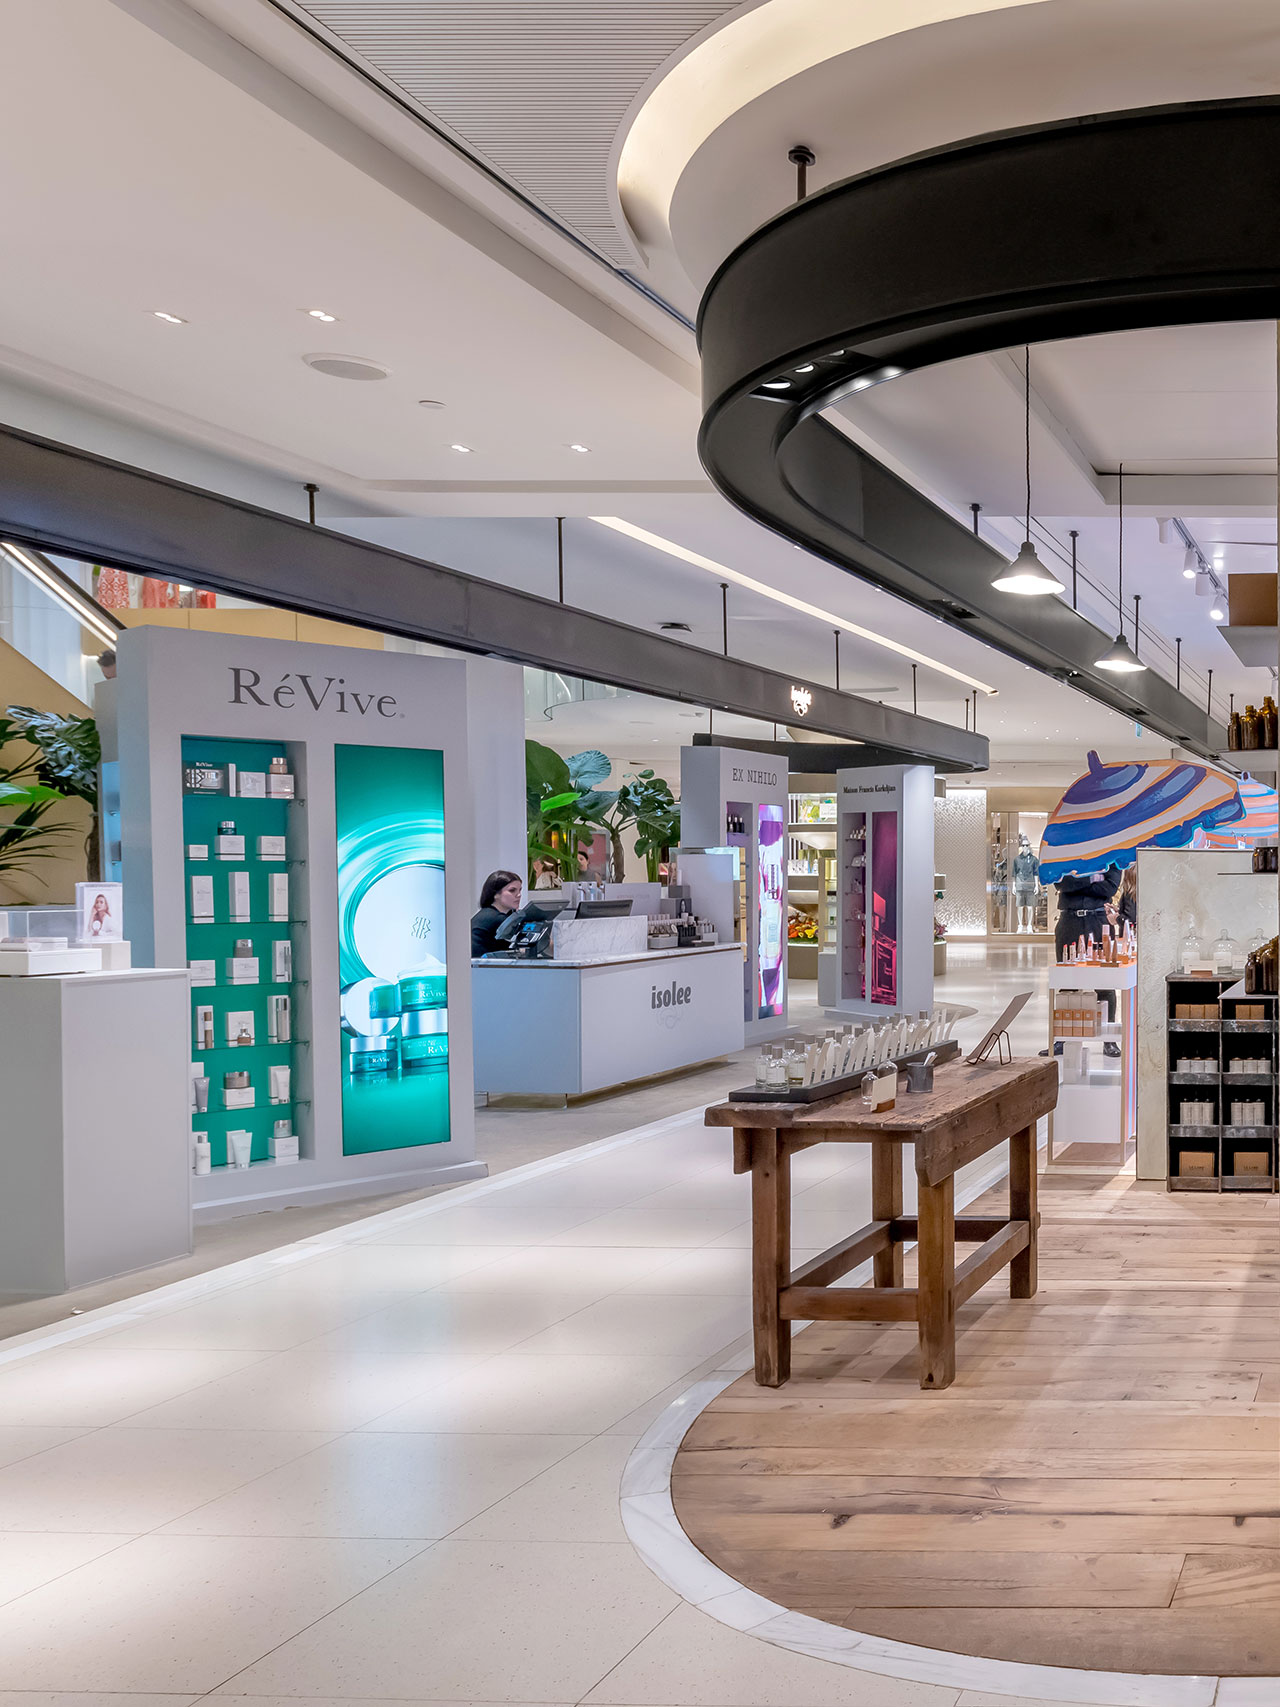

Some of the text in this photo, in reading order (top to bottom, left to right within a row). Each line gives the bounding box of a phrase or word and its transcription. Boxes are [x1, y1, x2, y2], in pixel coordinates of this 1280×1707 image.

[228, 667, 397, 718] RéVive
[732, 768, 778, 786] EX NIHILO
